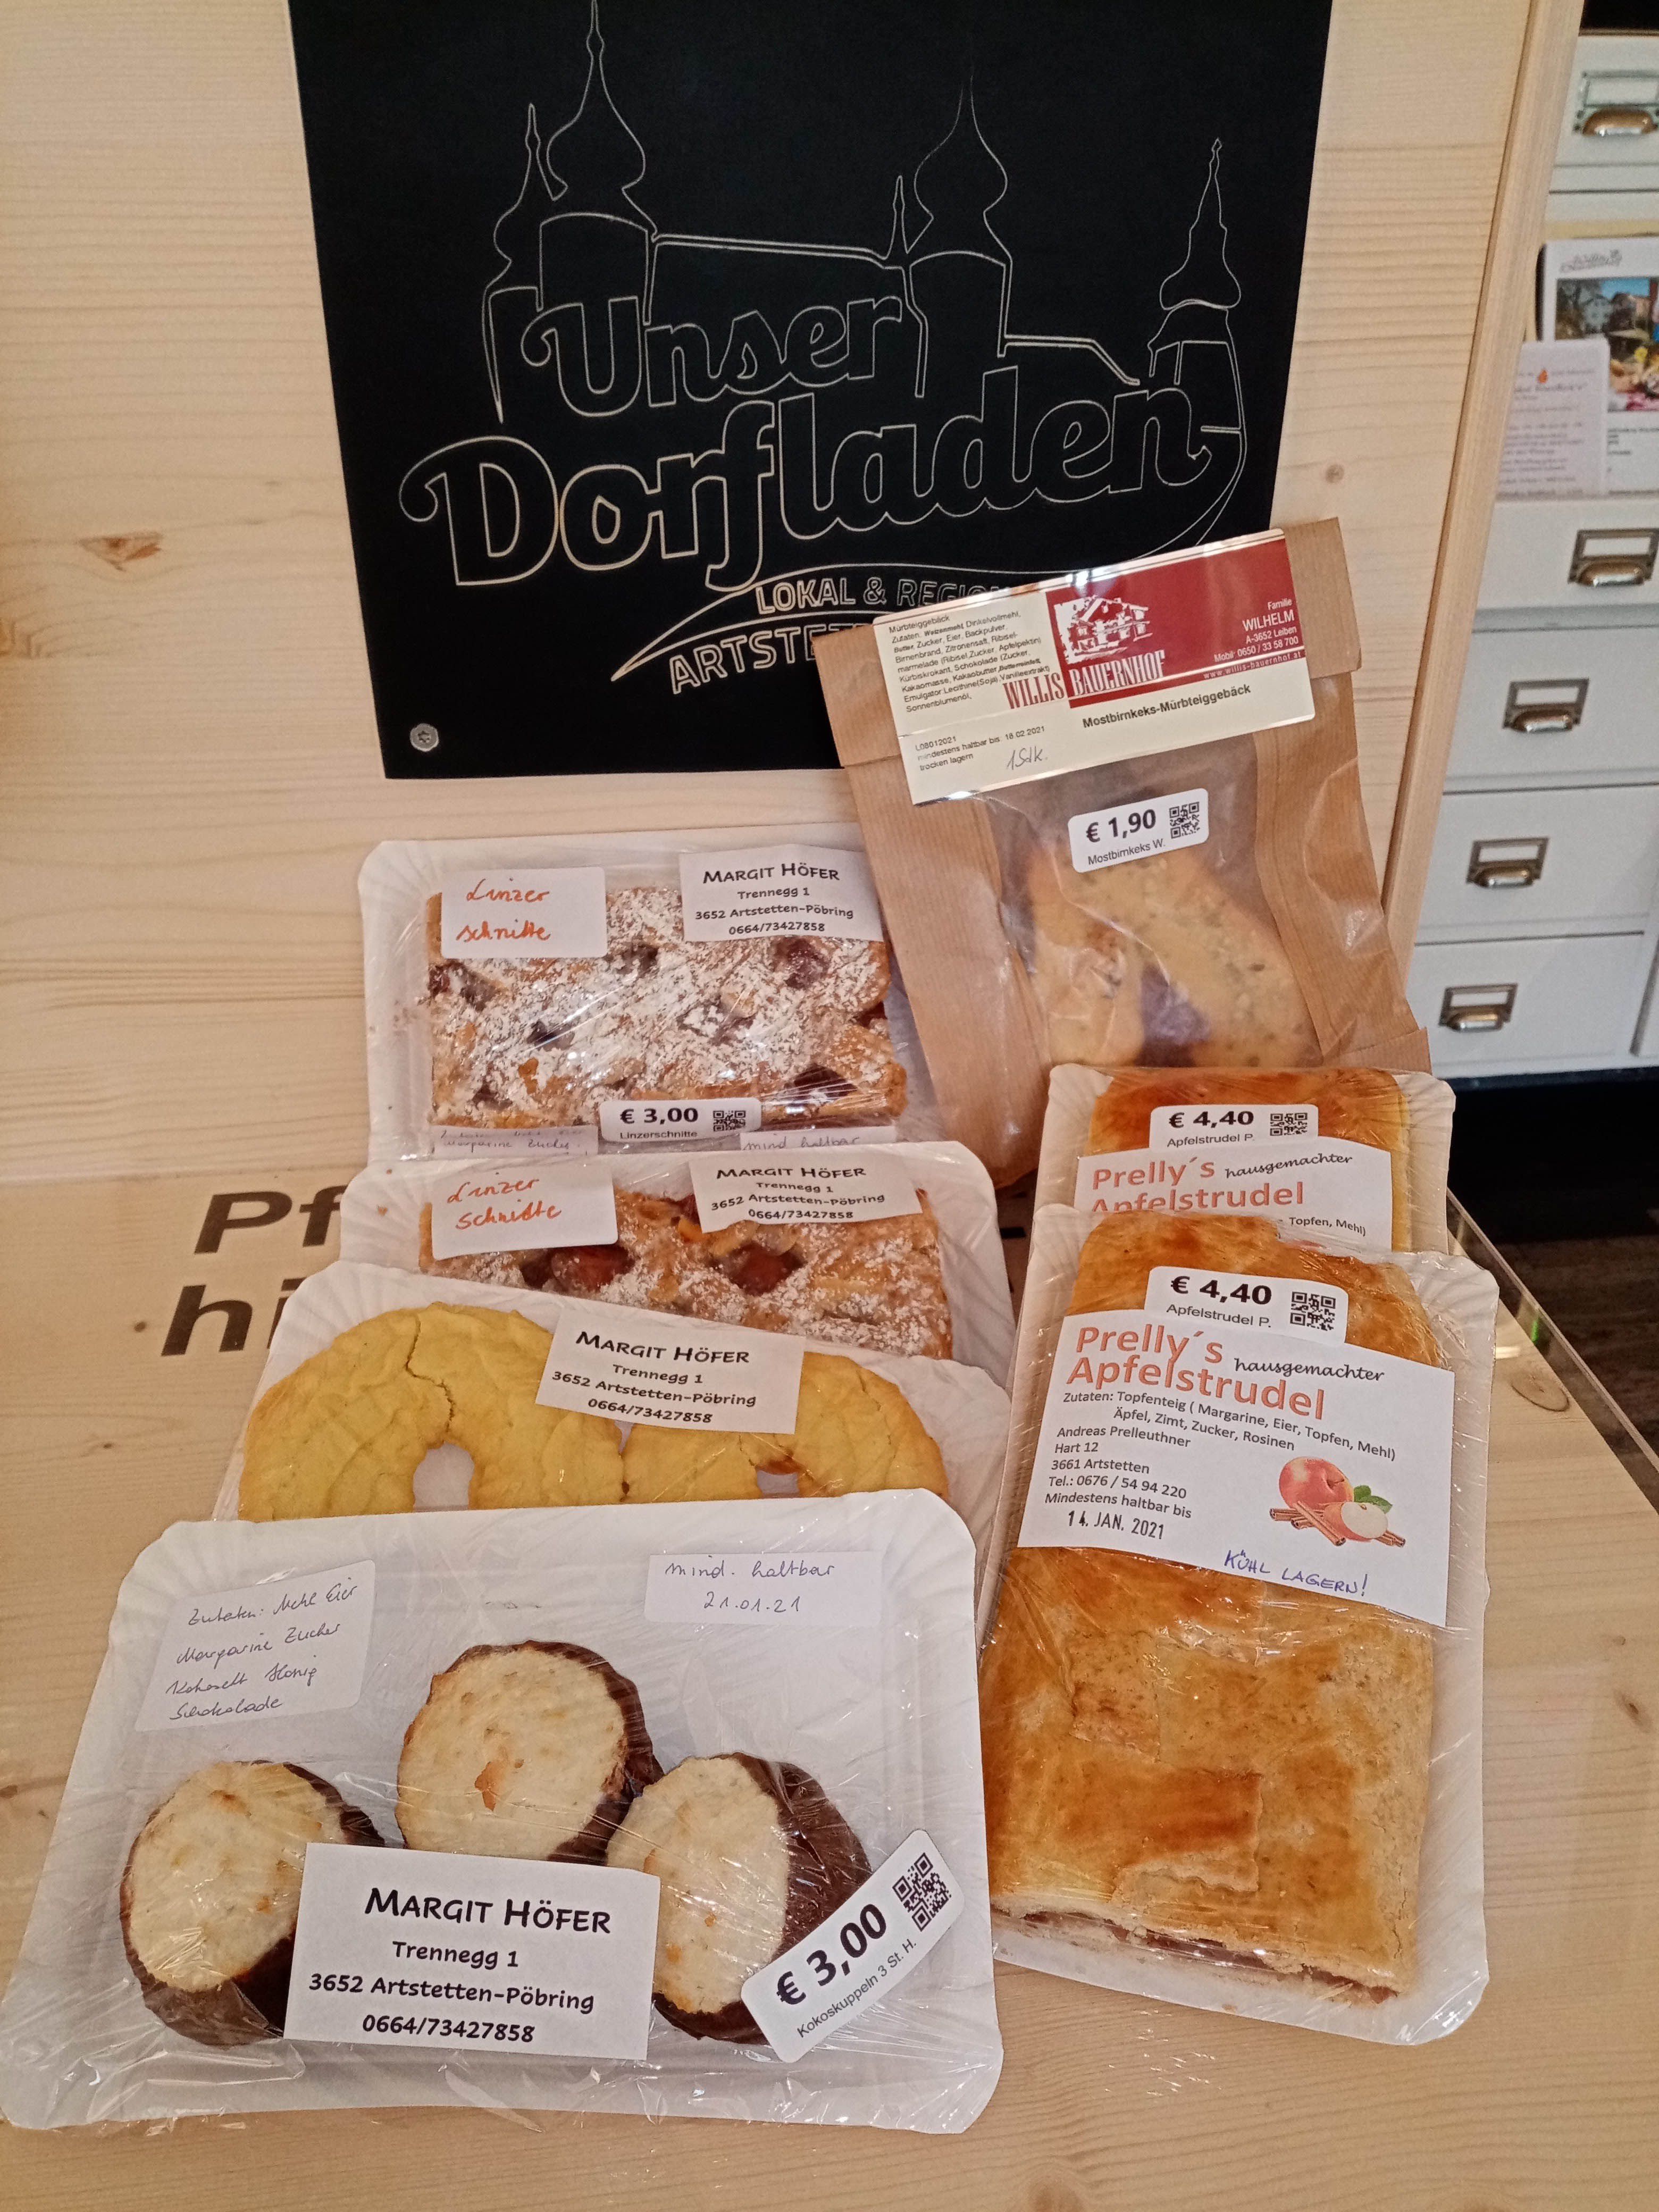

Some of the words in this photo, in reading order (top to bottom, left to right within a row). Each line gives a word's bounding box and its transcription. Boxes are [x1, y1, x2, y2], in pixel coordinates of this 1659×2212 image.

[521, 294, 904, 417] Unser
[399, 367, 1212, 590] Dorfladen
[756, 577, 856, 614] LOKAL
[863, 576, 886, 605] &
[896, 579, 1000, 607] REGI
[1267, 598, 1292, 610] Familie
[1242, 609, 1295, 631] WILHELM
[1245, 631, 1272, 644] A-3652
[1273, 625, 1297, 637] Leiben
[1237, 646, 1256, 657] 0650
[1262, 642, 1272, 651] 33
[1273, 639, 1284, 648] 58
[1285, 636, 1299, 647] 700
[669, 623, 873, 694] ARTSTE
[898, 660, 939, 673] marmelade
[954, 656, 998, 671] Schokolade
[1003, 673, 1066, 709] WILLIS
[1069, 652, 1167, 698] BAUERNHOF
[1083, 683, 1251, 728] Mostbirnkeks-Mürbteiggebäck
[918, 747, 960, 761] mindestens
[962, 740, 987, 750] haltbar
[919, 759, 948, 771] trocken
[950, 752, 974, 766] lagern
[1086, 822, 1100, 842] €
[1108, 809, 1156, 839] 1,90
[1088, 844, 1151, 865] Mostbirnkeks
[703, 867, 775, 884] MARGIT
[781, 862, 840, 881] HÖFER
[737, 887, 798, 900] Trennegg
[803, 887, 810, 896] 1
[695, 910, 726, 919] 3652
[730, 904, 854, 919] Artstetten-Pöbring
[729, 921, 825, 935] 0664/73427858
[620, 1109, 635, 1124] €
[644, 1108, 699, 1125] 3,00
[1169, 1112, 1185, 1128] €
[1193, 1111, 1254, 1128] 4,40
[620, 1130, 698, 1139] Linzerschnitte
[1167, 1134, 1240, 1147] Apfelstrudel
[717, 1168, 793, 1179] MARGIT
[801, 1168, 866, 1178] HÖFER
[1225, 1153, 1353, 1178] hausgemachter
[756, 1182, 821, 1193] Trennegg
[711, 1196, 744, 1211] 3652
[749, 1194, 885, 1206] Artstetten-Pöbring
[748, 1209, 853, 1219] 0664/73427858
[1289, 1217, 1333, 1227] Topfen,
[1336, 1218, 1366, 1237] Mehl)
[1171, 1276, 1191, 1294] €
[1200, 1279, 1272, 1305] 4,40
[1166, 1304, 1253, 1326] Apfelstrudel
[1259, 1317, 1271, 1328] P.
[575, 1331, 666, 1359] MARGIT
[673, 1346, 750, 1363] HÖFER
[613, 1363, 689, 1384] Trennegg
[694, 1374, 703, 1384] 1
[1234, 1358, 1385, 1381] hausgemachter
[552, 1371, 591, 1387] 3652
[596, 1381, 756, 1407] Artstetten-Pöbring
[1066, 1354, 1325, 1420] Apfelstrudel
[588, 1398, 713, 1423] 0664/73427858
[1057, 1426, 1106, 1437] Andreas
[1110, 1426, 1191, 1447] Prelleuthner
[1063, 1392, 1113, 1403] Zutaten:
[1117, 1391, 1186, 1412] Topfenteig
[1189, 1401, 1195, 1414] (
[1198, 1403, 1269, 1428] Margarine,
[1273, 1418, 1301, 1436] Eier,
[1305, 1426, 1353, 1450] Topfen,
[1358, 1440, 1396, 1461] Mehl)
[1113, 1406, 1151, 1423] Äpfel,
[1154, 1413, 1187, 1430] Zimt,
[1191, 1420, 1238, 1441] Zucker,
[1243, 1431, 1295, 1451] Rosinen
[1054, 1443, 1081, 1453] Hart
[1084, 1442, 1099, 1452] 12
[1051, 1459, 1080, 1470] 3661
[1084, 1459, 1150, 1474] Artstetten
[1049, 1476, 1073, 1486] Tel.:
[1076, 1475, 1108, 1486] 0676
[1110, 1476, 1119, 1489] /
[1121, 1478, 1137, 1489] 54
[1141, 1480, 1158, 1493] 94
[1161, 1484, 1187, 1499] 220
[1045, 1492, 1117, 1504] Mindestens
[1121, 1495, 1170, 1513] haltbar
[1172, 1504, 1192, 1519] bis
[1094, 1512, 1124, 1531] JAN.
[1131, 1518, 1164, 1539] 2021
[665, 1554, 736, 1579] mind.
[751, 1560, 835, 1578] haltbar
[1224, 1549, 1270, 1574] KÜHL
[1281, 1568, 1368, 1596] LAGERN!
[703, 1591, 801, 1613] 21.01.21
[365, 1887, 493, 1924] MARGIT
[504, 1898, 611, 1934] HÖFER
[392, 1941, 498, 1970] Trennegg
[507, 1950, 519, 1967] 1
[776, 1971, 807, 2006] €
[806, 1904, 887, 1987] 3,00
[308, 1972, 363, 1993] 3652
[371, 1977, 594, 2014] Artstetten-Pöbring
[797, 1974, 879, 2038] Kokoskuppeln
[877, 1965, 888, 1977] 3
[887, 1953, 905, 1968] St.
[902, 1940, 917, 1954] H.
[363, 2014, 535, 2043] 0664/73427858
